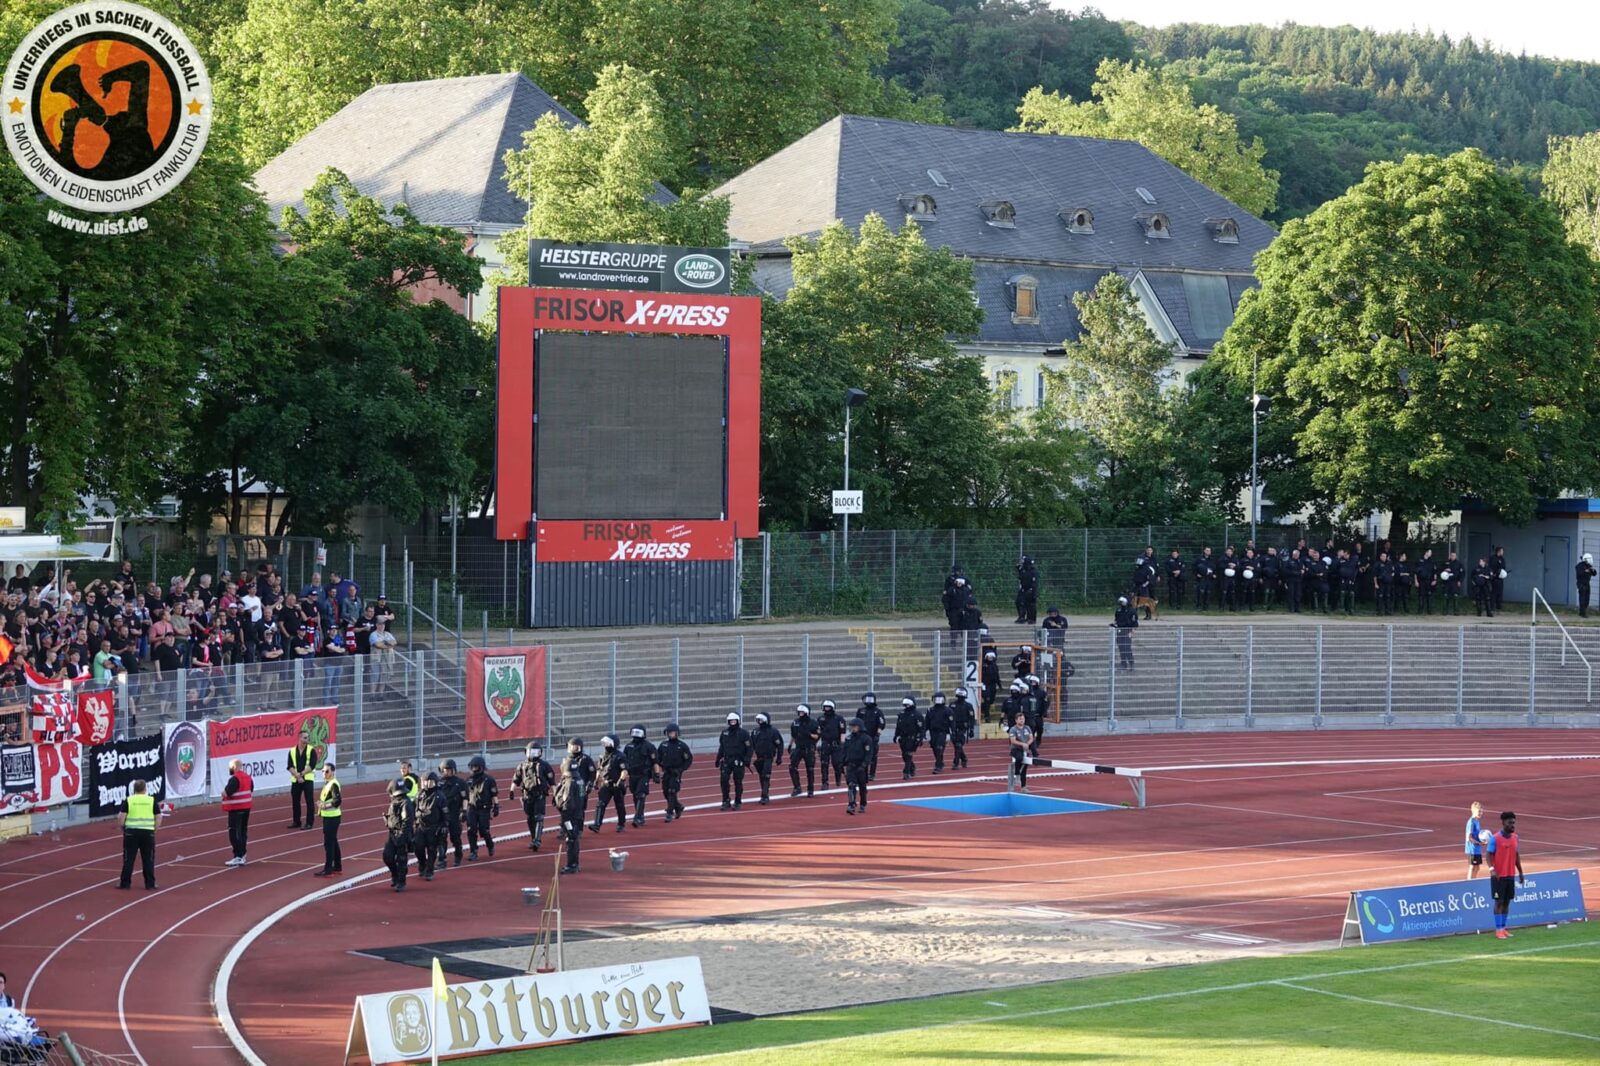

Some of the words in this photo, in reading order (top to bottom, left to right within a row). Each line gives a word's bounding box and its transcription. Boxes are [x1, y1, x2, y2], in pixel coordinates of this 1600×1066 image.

[540, 248, 667, 269] HEISTERGRUPPE
[685, 260, 709, 270] LAND
[559, 271, 650, 284] www.landrover-trier.de
[687, 269, 715, 280] ROVER
[625, 300, 730, 327] X-PRESS
[834, 497, 854, 507] BLOCK
[856, 496, 861, 506] C
[609, 540, 691, 560] X-PRESS
[966, 661, 977, 681] 2
[38, 741, 80, 801] PS
[1539, 890, 1551, 900] 1-3
[1552, 888, 1568, 899] Jahre
[1398, 899, 1445, 917] Berens
[1448, 894, 1460, 911] &
[1462, 892, 1489, 910] Cie.
[1402, 916, 1463, 931] Aktiengesellschaft
[447, 978, 685, 1050] Bitburger
